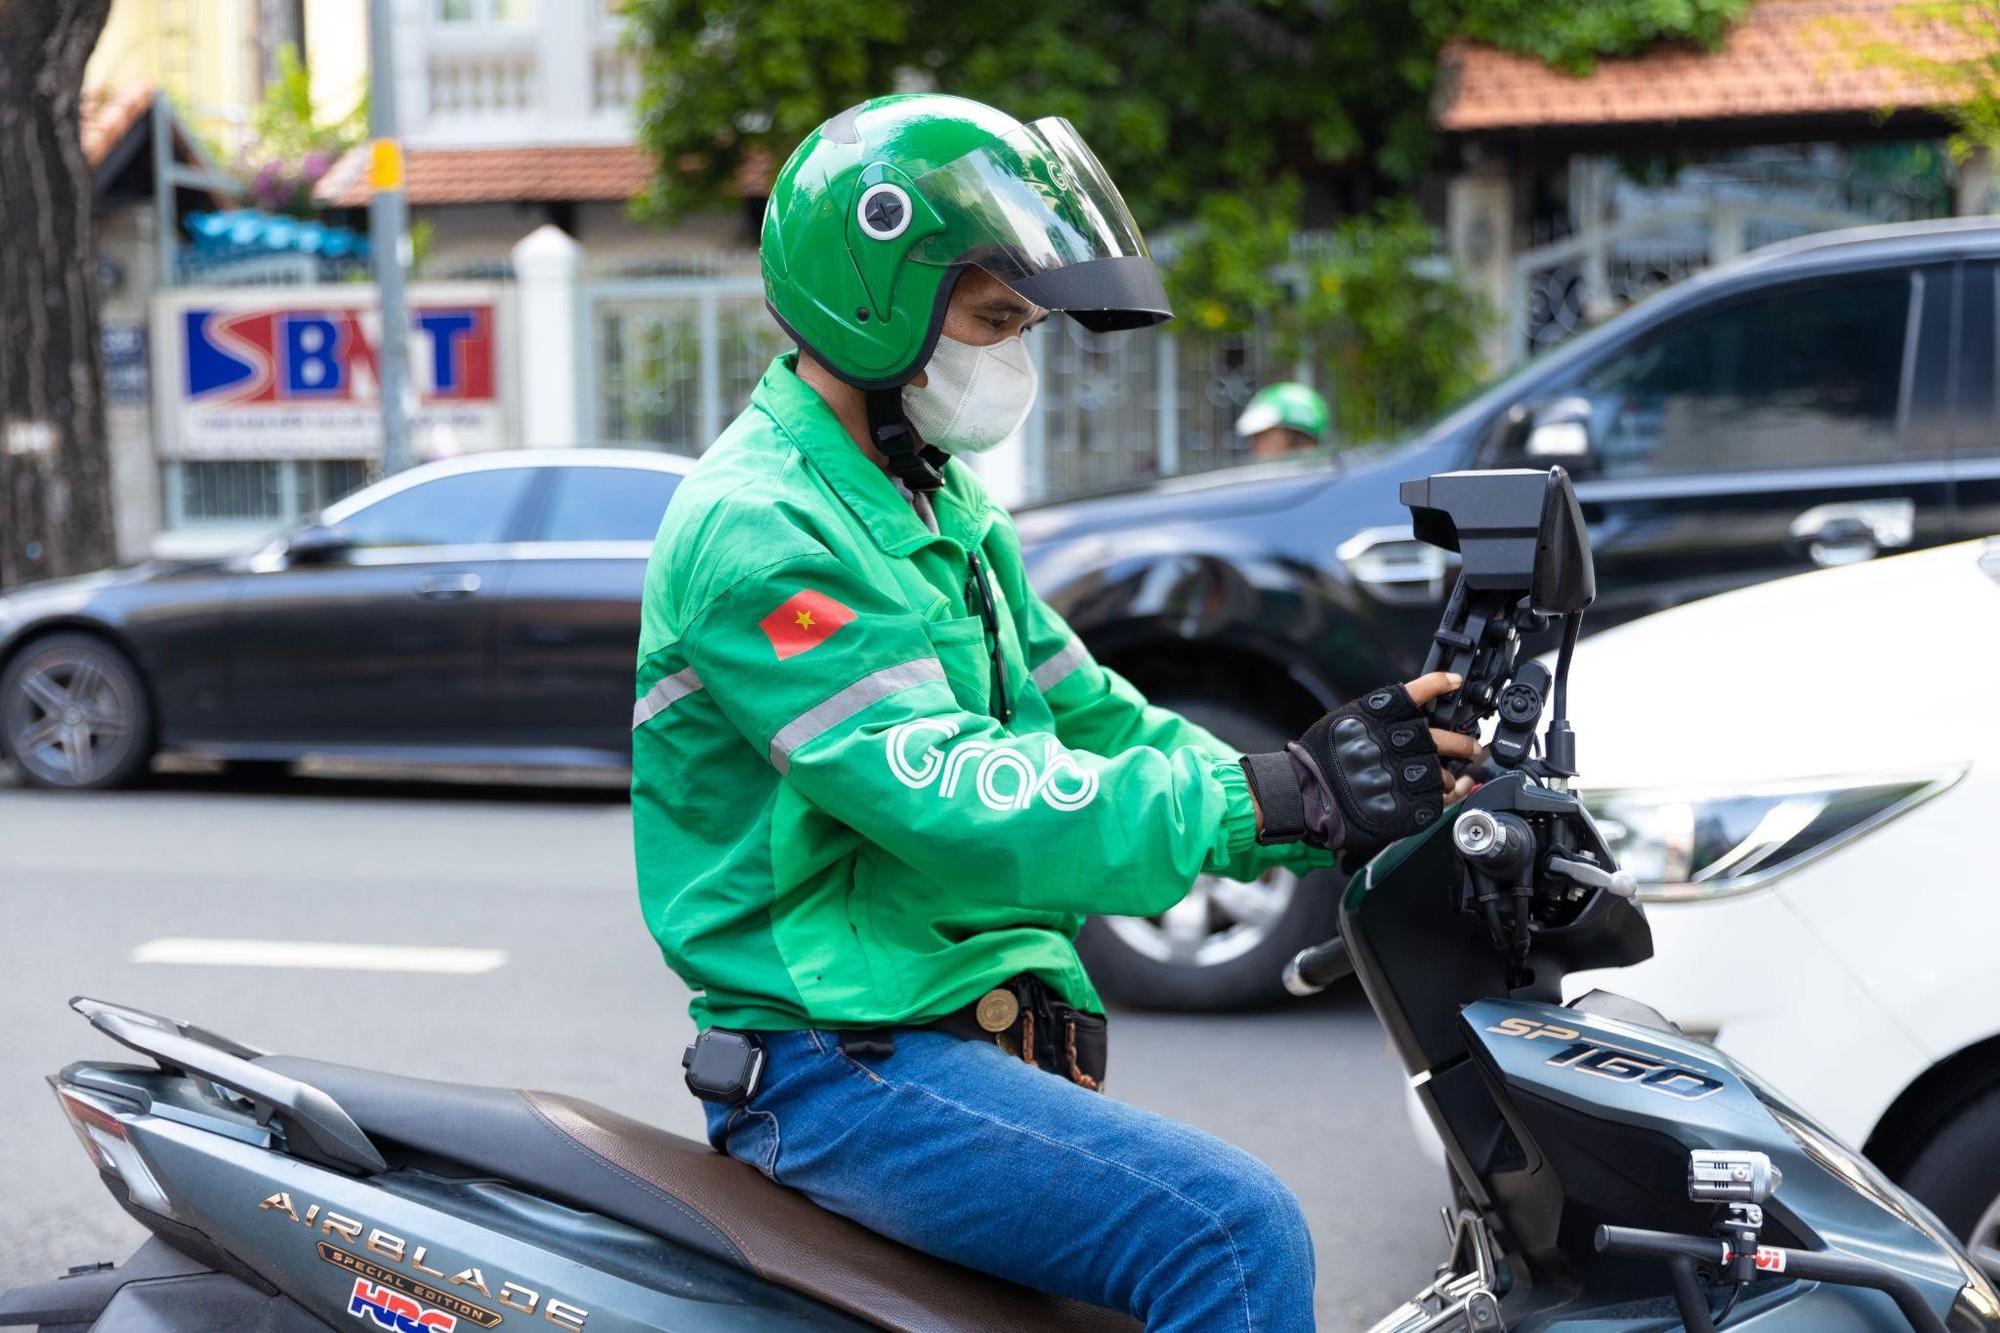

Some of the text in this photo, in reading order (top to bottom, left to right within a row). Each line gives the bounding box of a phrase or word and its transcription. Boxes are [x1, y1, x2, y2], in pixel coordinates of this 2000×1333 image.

[886, 718, 1099, 812] Grab
[1485, 1017, 1580, 1041] SP
[1545, 1042, 1725, 1101] 160
[259, 1191, 589, 1333] AIRBLADE
[332, 1251, 484, 1320] SPECIAL EDITION
[348, 1278, 457, 1333] HRC
